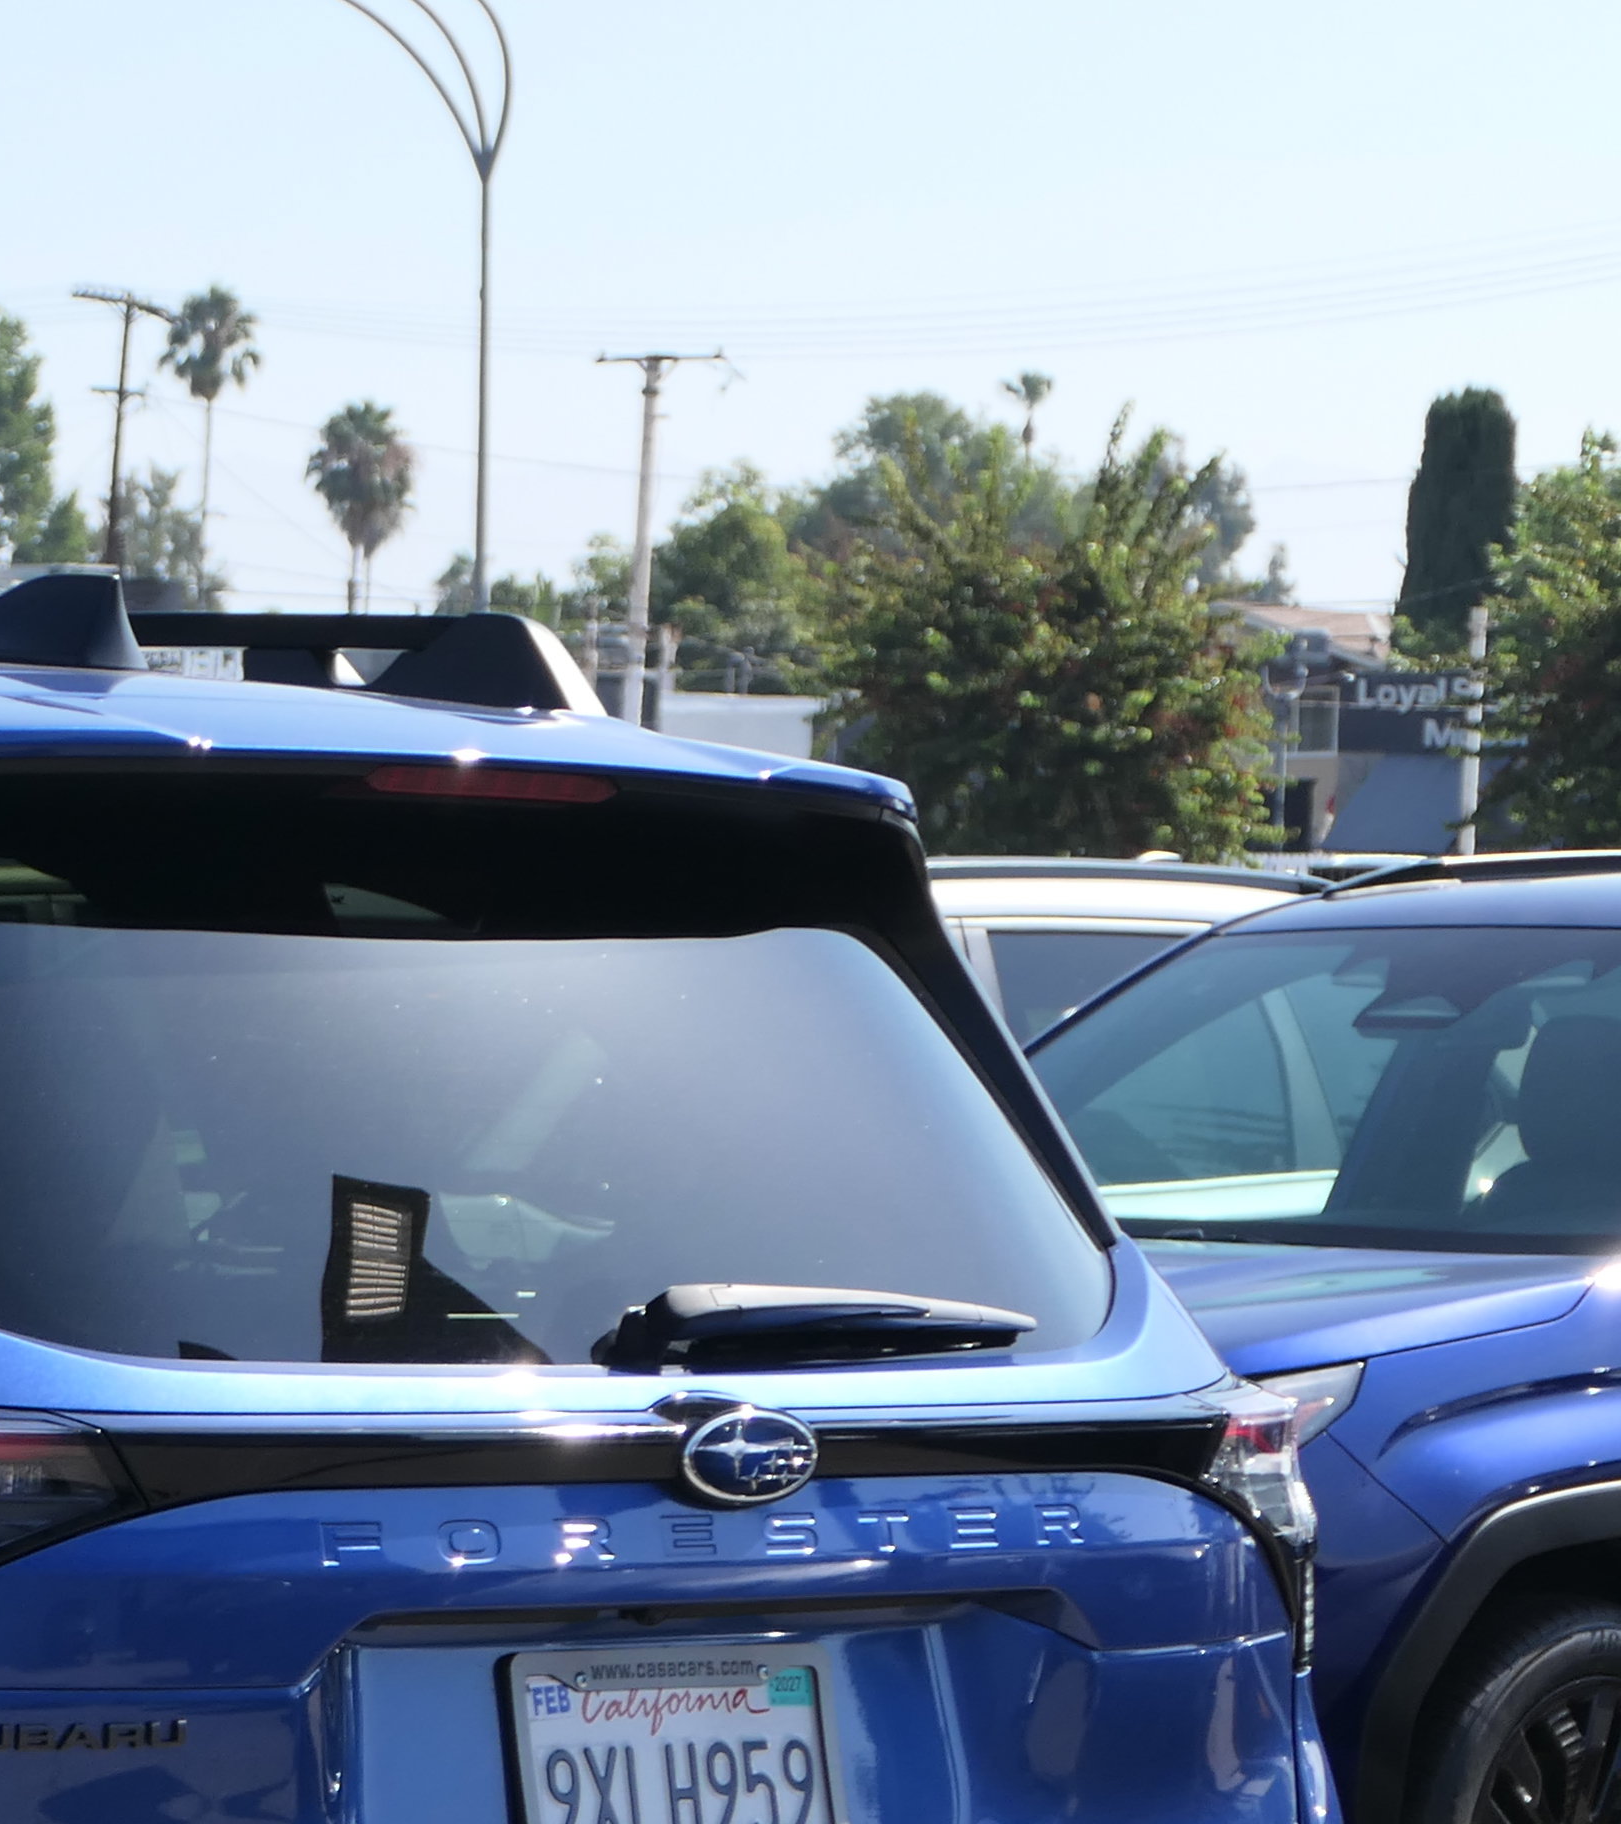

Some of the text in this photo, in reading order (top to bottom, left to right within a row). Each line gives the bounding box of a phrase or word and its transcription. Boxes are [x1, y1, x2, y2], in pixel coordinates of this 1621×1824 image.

[1358, 677, 1447, 714] Loyal
[320, 1501, 1085, 1567] FORESTER
[590, 1659, 756, 1681] www.casacars.com
[773, 1675, 803, 1693] 2027
[531, 1684, 572, 1717] FEB
[581, 1687, 771, 1737] California
